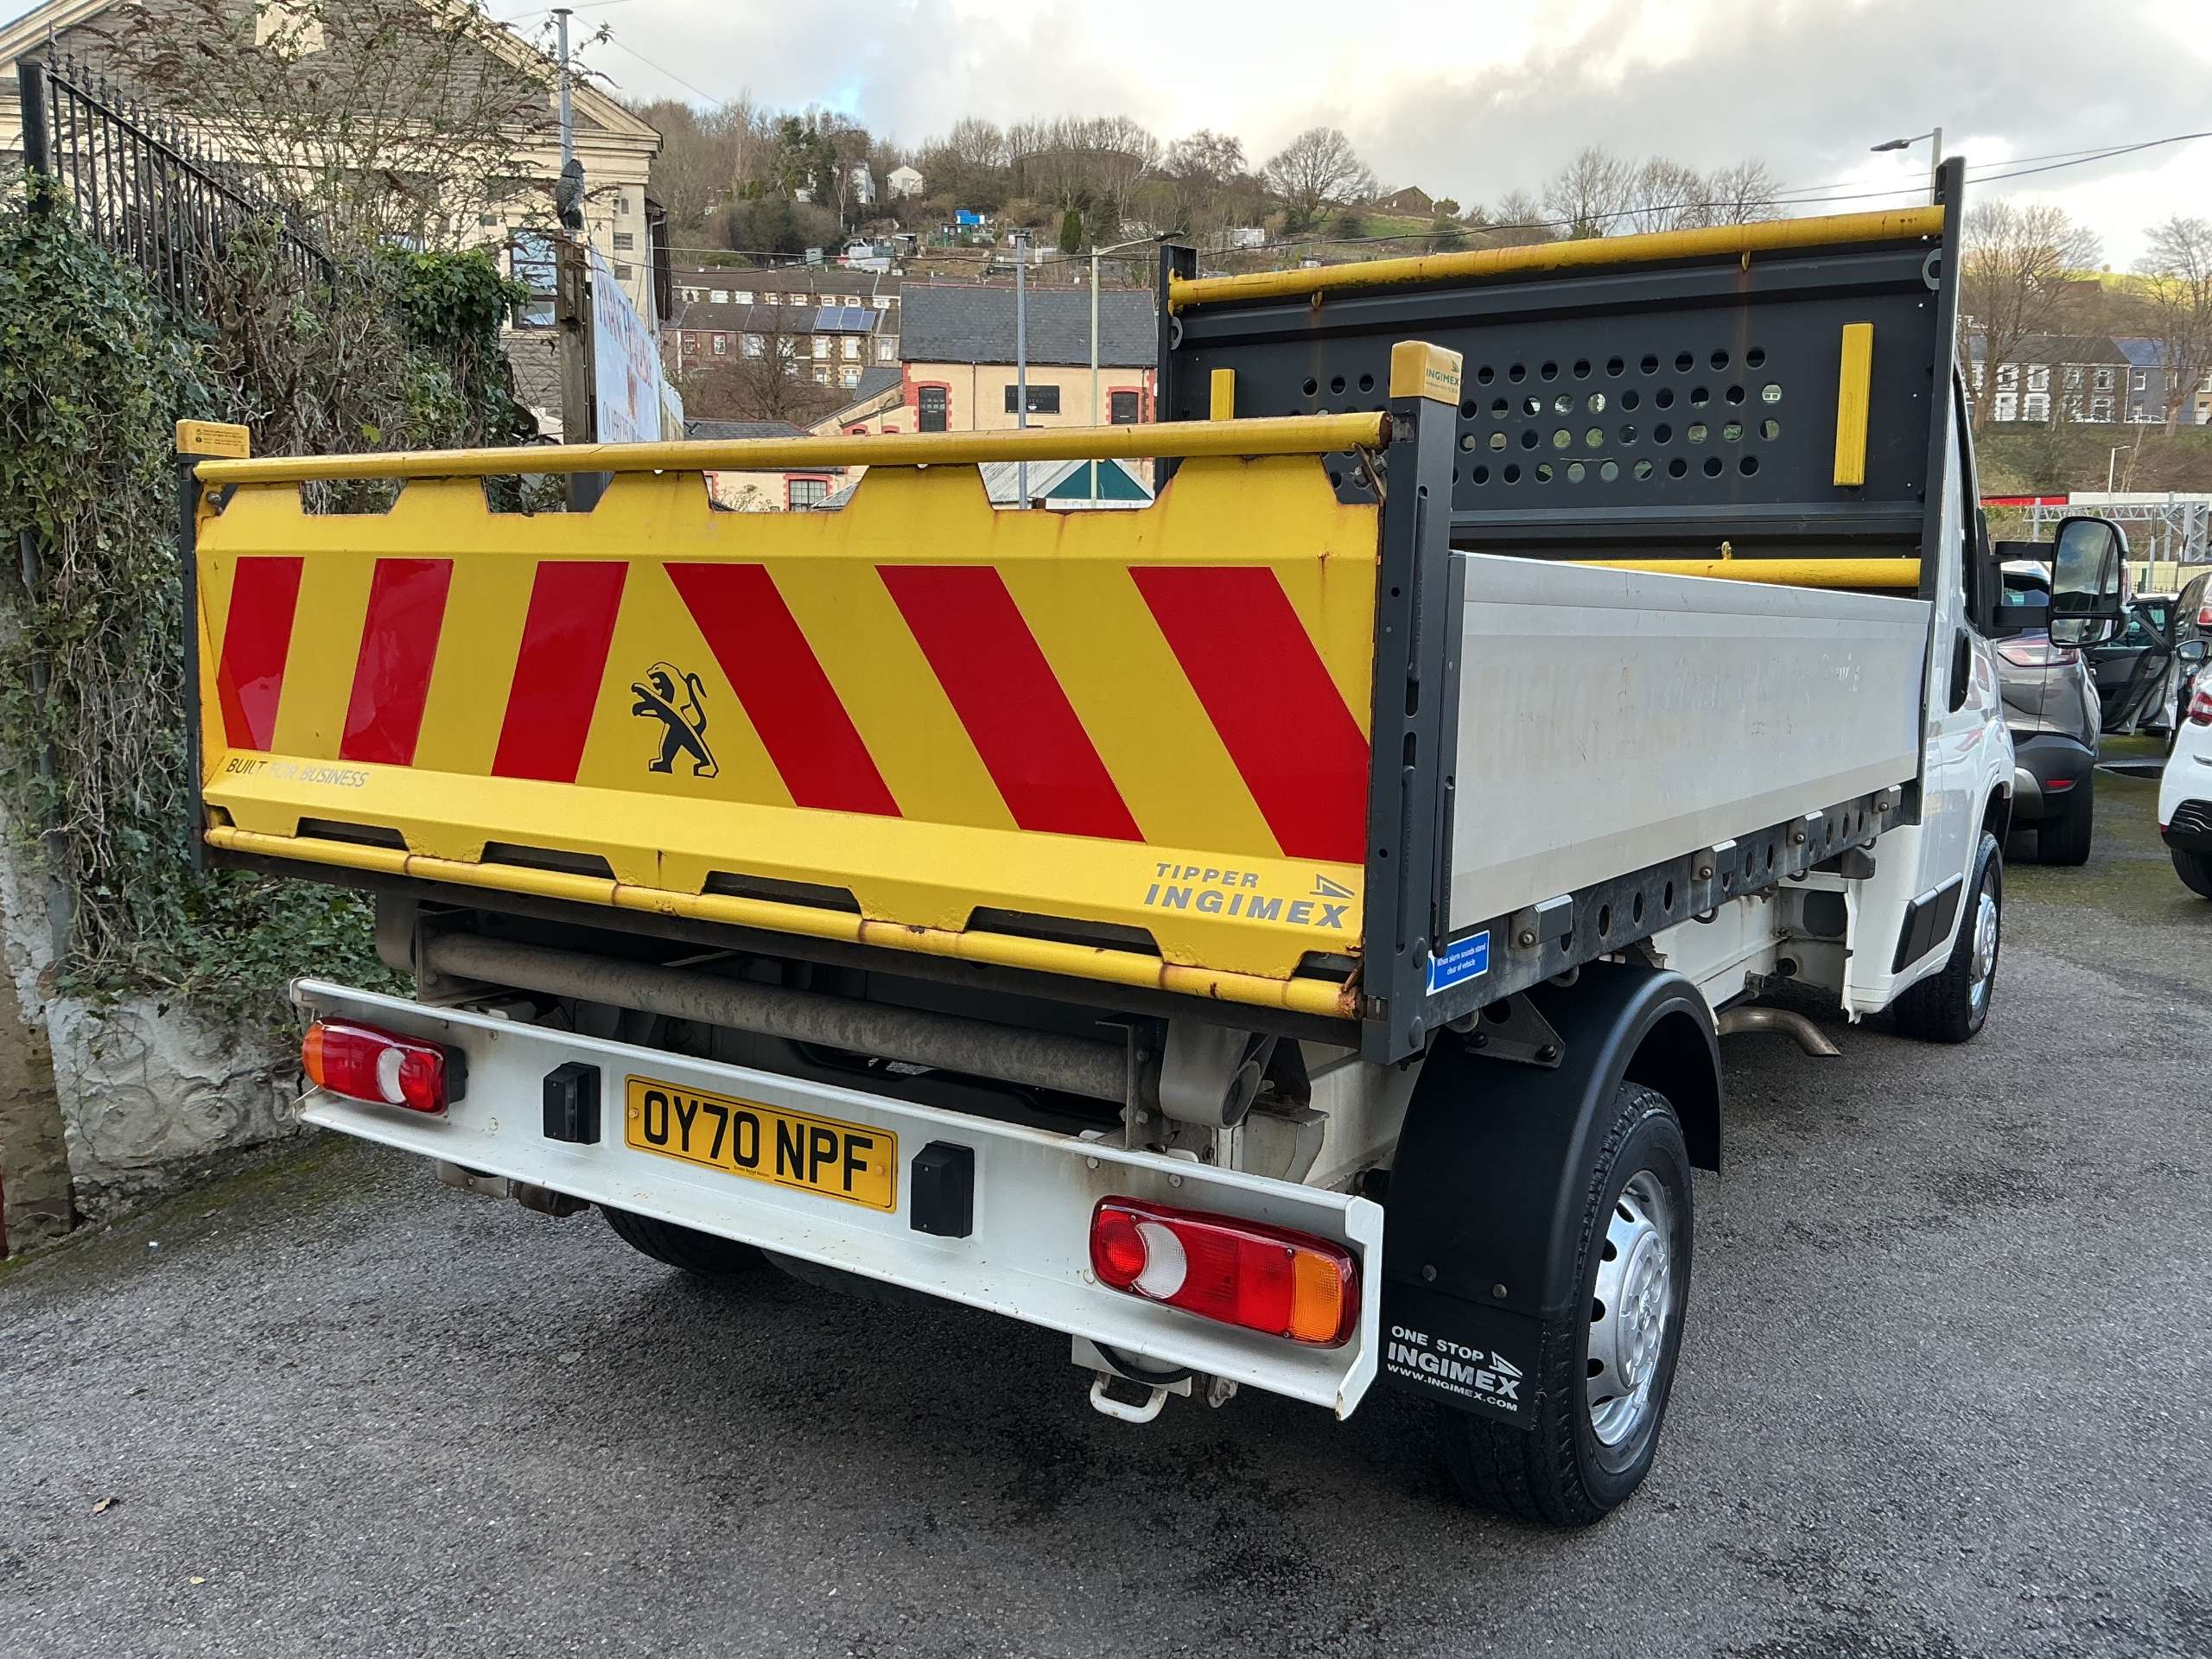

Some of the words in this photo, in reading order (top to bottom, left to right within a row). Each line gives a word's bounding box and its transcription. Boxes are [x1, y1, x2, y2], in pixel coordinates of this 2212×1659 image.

[1426, 368, 1459, 386] INGIMEX
[226, 758, 268, 775] BUILT
[269, 761, 298, 779] FOR
[300, 766, 370, 787] BUSINESS
[1156, 862, 1259, 888] TIPPER
[1144, 883, 1350, 929] INGIMEX
[1437, 957, 1449, 967] When
[644, 1090, 760, 1168] OY70
[777, 1118, 874, 1192] NPF
[1391, 1325, 1428, 1346] ONE
[1436, 1338, 1484, 1362] STOP
[1387, 1341, 1521, 1401] INGIMEX
[1387, 1363, 1518, 1412] WWW.INGIMEX.COM
